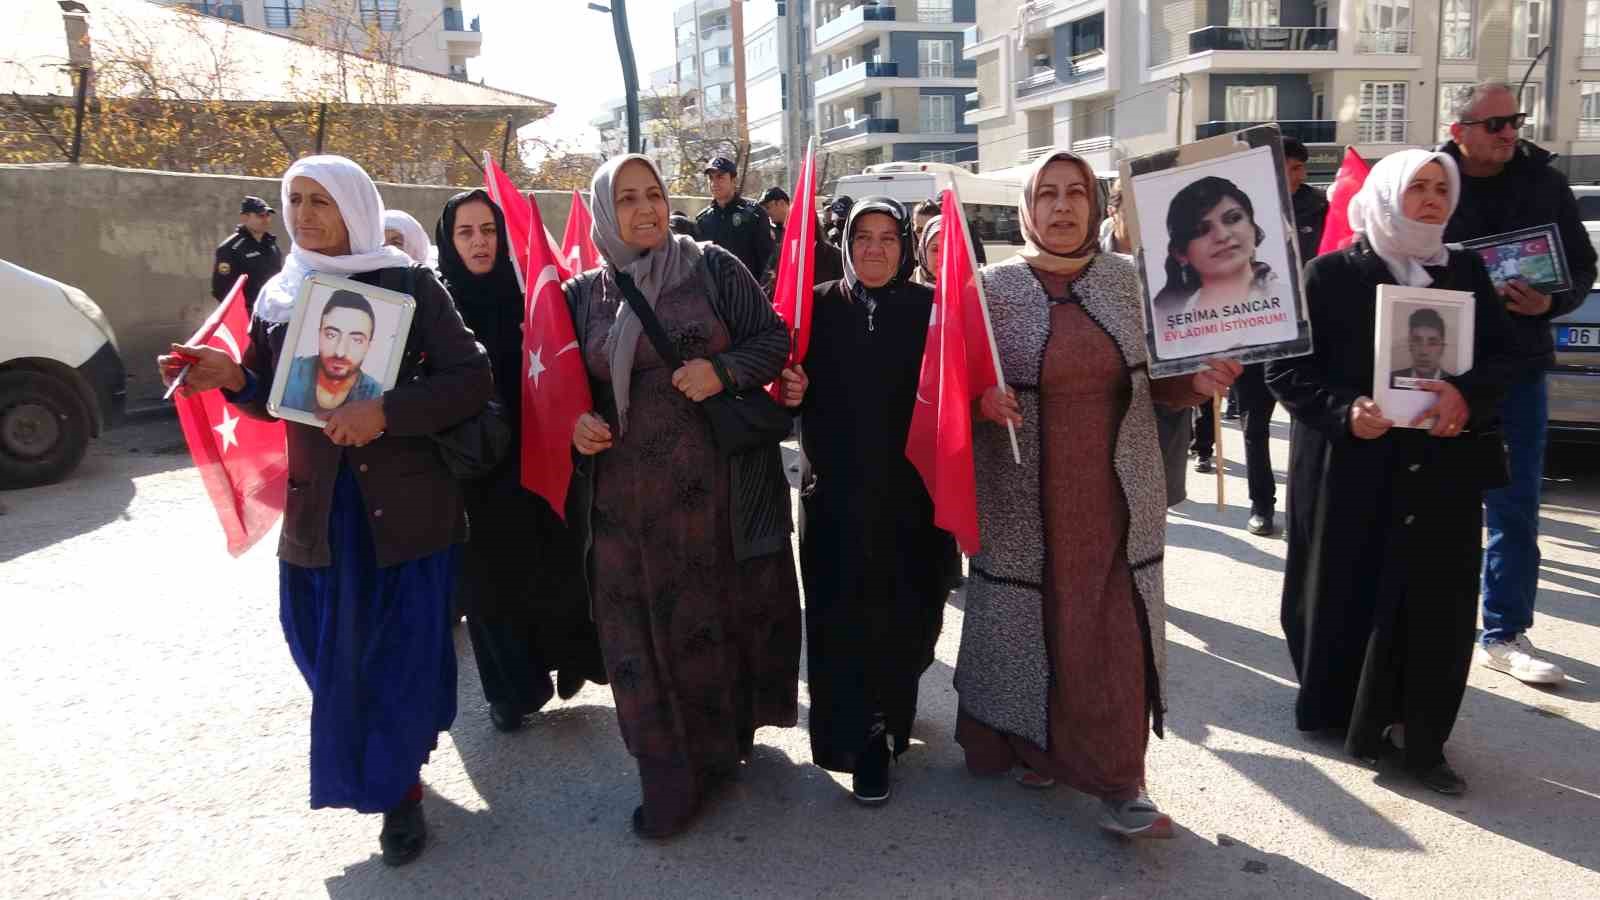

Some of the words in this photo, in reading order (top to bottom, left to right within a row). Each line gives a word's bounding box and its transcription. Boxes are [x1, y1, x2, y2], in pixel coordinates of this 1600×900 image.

[1164, 325, 1218, 342] EVLADIMI
[1221, 312, 1288, 332] İSTİYORUM!
[1167, 309, 1219, 329] ŞERİMA
[1223, 297, 1281, 318] SANCAR
[1568, 328, 1591, 345] 06
